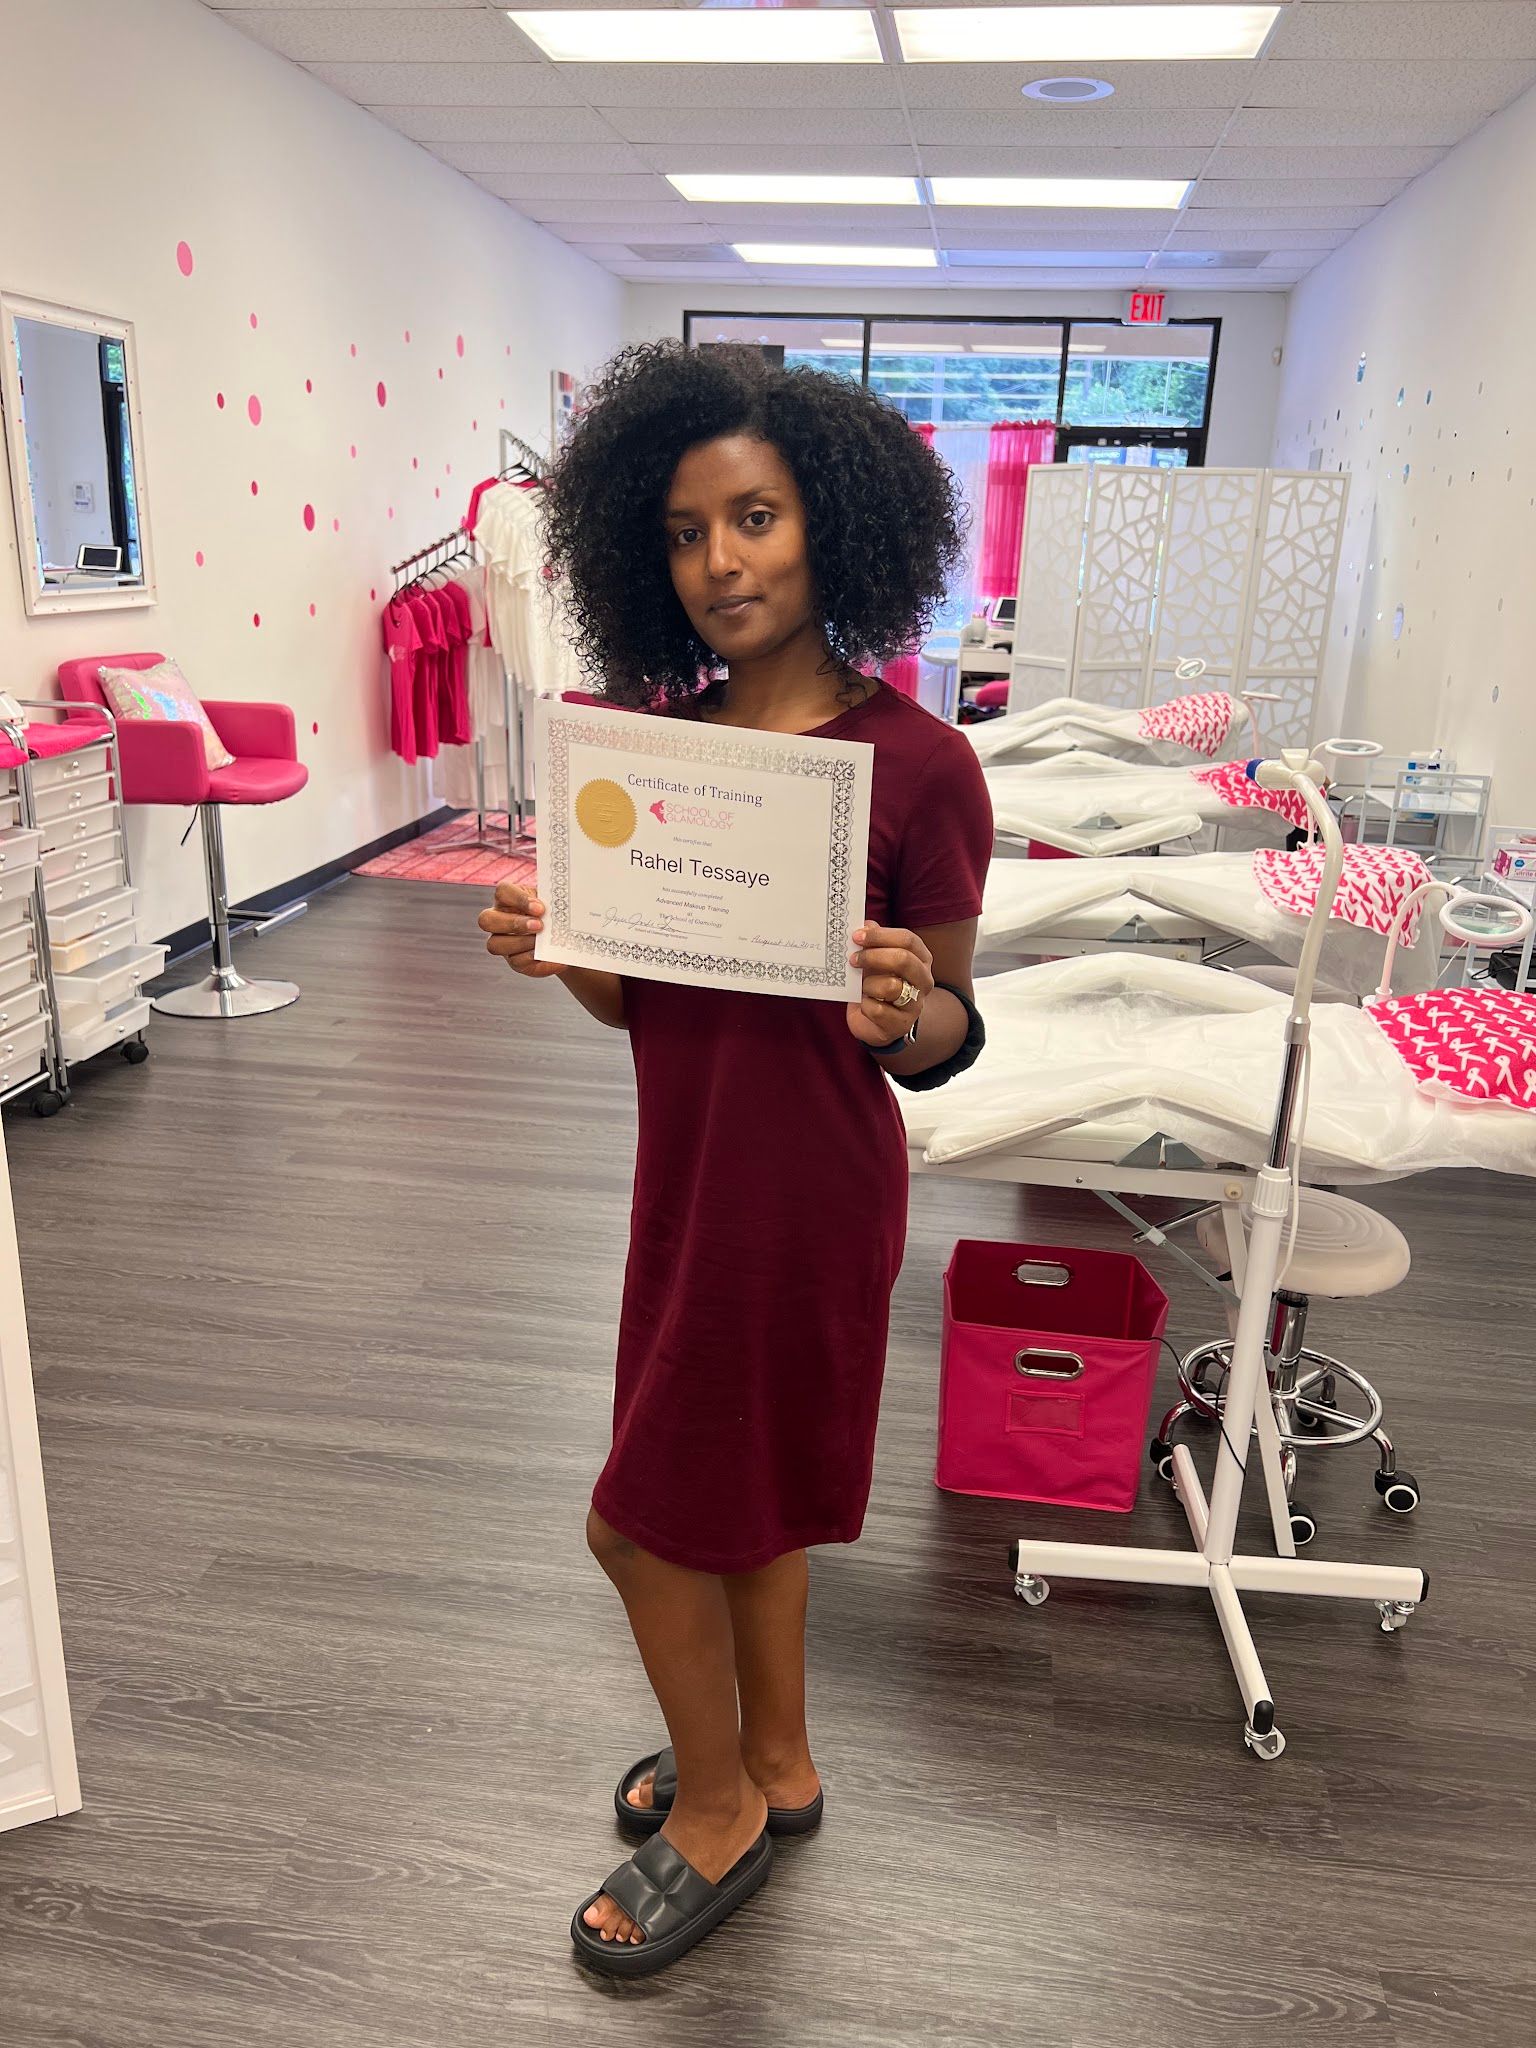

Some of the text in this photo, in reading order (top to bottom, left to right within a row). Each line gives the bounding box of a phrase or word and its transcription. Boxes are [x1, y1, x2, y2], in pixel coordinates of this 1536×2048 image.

[1130, 294, 1165, 321] EXIT
[627, 773, 763, 808] Certificate of Training
[665, 813, 734, 831] GLAMOLOGY
[666, 803, 736, 822] SCHOOL OF
[630, 849, 770, 889] Rahel Tessaye
[656, 897, 730, 915] Advanced Makeup Training
[670, 914, 688, 922] School
[694, 919, 722, 928] Glamology
